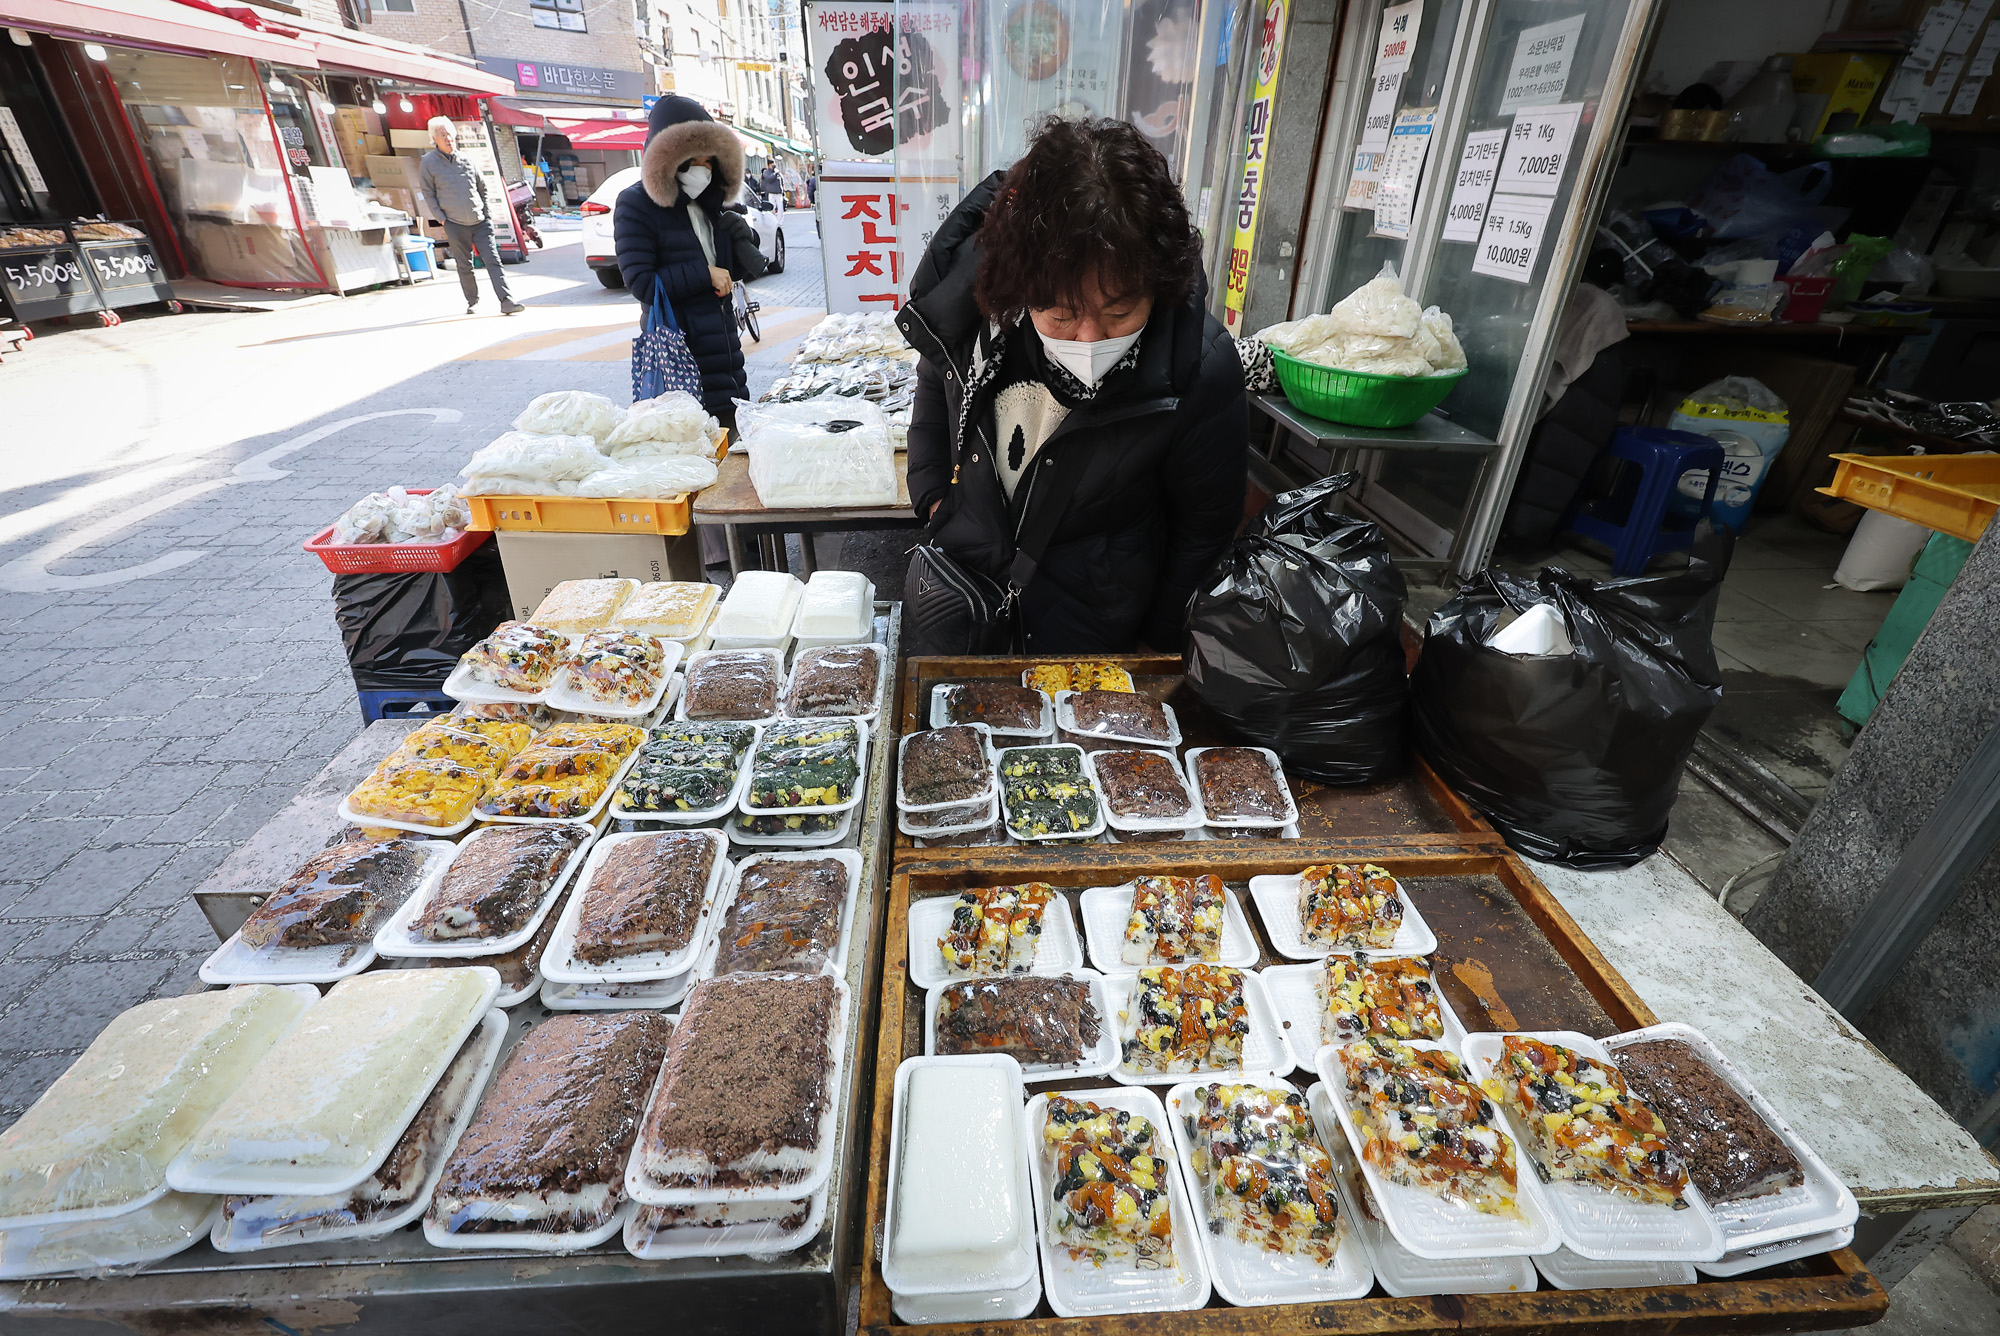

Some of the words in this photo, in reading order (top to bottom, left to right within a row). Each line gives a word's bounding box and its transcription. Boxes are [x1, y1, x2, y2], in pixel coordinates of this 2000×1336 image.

[818, 11, 859, 32] 자연담은
[860, 11, 890, 34] 해풍에
[1383, 40, 1407, 58] 5000원
[1527, 35, 1566, 55] 소문난떡집
[842, 35, 912, 97] 인생
[543, 65, 616, 90] 바다한스푼
[1377, 73, 1400, 92] 옹심이
[1844, 78, 1876, 90] Maxim
[857, 87, 931, 133] 국수
[1366, 114, 1391, 130] 5,000원
[1515, 123, 1533, 141] 떡국
[1537, 124, 1556, 142] 1Kg
[287, 148, 311, 166] 만두
[1464, 142, 1500, 160] 고기만두
[1518, 153, 1562, 176] 7,000원
[1458, 169, 1493, 187] 김치만두
[1450, 202, 1484, 222] 4,000원
[1488, 215, 1504, 232] 떡국
[1508, 219, 1533, 239] 1.5Kg
[1486, 244, 1532, 268] 10,000원
[650, 560, 660, 572] ISO
[521, 605, 531, 617] Tel
